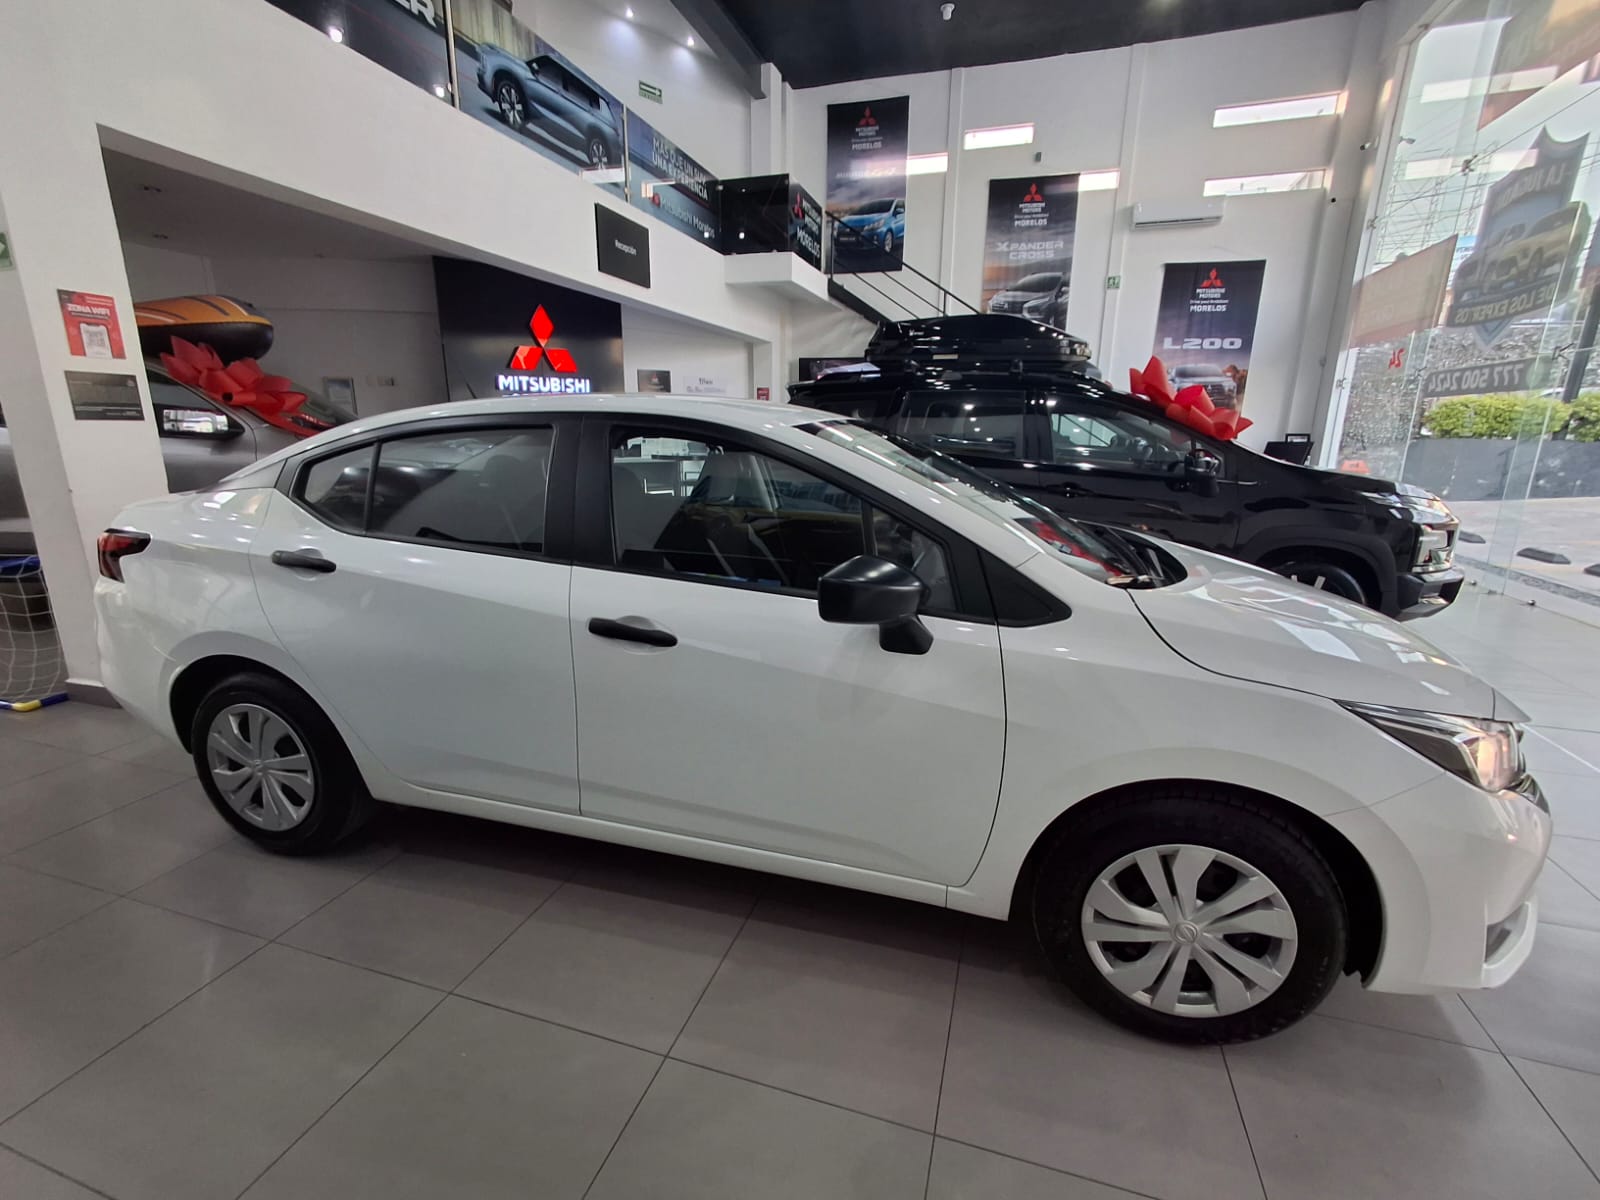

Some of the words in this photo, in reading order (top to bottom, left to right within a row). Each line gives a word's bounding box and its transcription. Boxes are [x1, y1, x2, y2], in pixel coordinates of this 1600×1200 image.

[1014, 218, 1047, 227] MORELOS
[796, 226, 820, 258] MORELOS
[996, 240, 1064, 251] XPANDER
[1009, 250, 1055, 260] CROSS
[1190, 304, 1226, 312] MORELOS
[1163, 337, 1242, 349] L200
[497, 375, 591, 393] MITSUBISHI
